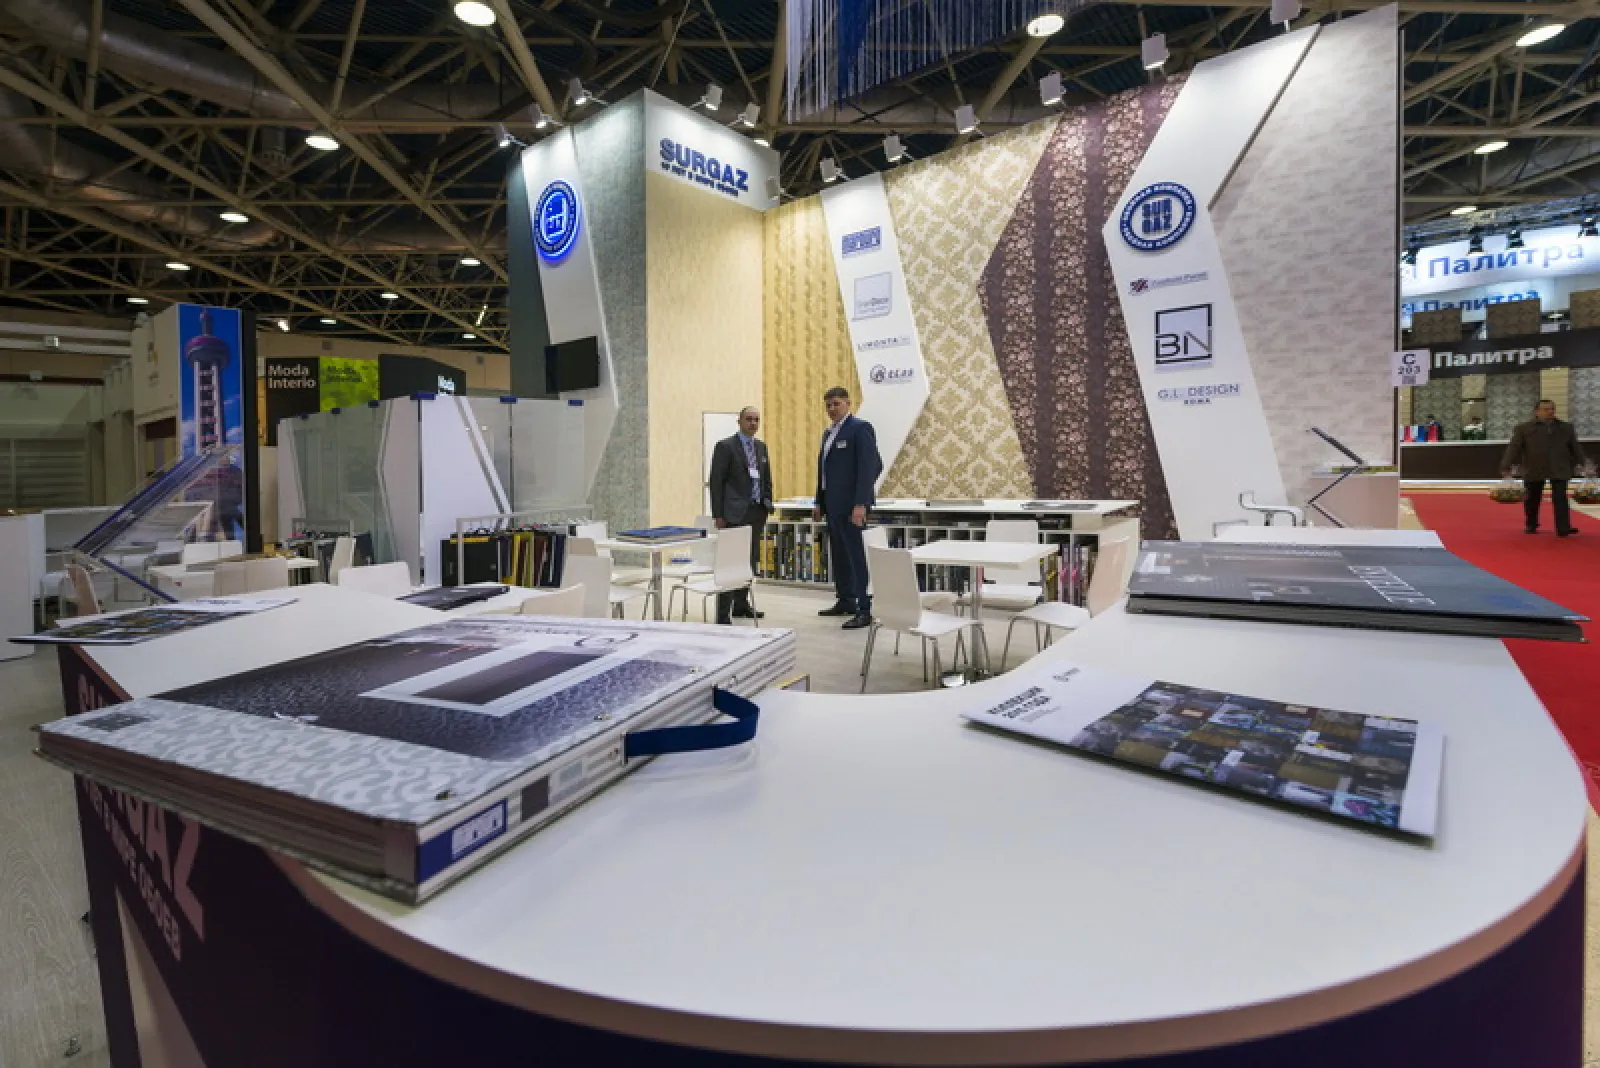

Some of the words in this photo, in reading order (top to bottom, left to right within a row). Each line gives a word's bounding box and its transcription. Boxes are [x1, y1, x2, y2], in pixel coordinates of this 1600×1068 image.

[659, 138, 749, 193] SURGAZ
[1429, 244, 1584, 278] Палитра
[1434, 346, 1554, 369] Палитра
[268, 364, 309, 377] Moda
[268, 377, 317, 389] Interio
[1187, 383, 1240, 398] DESIGN
[139, 861, 182, 962] ОБОЕВ
